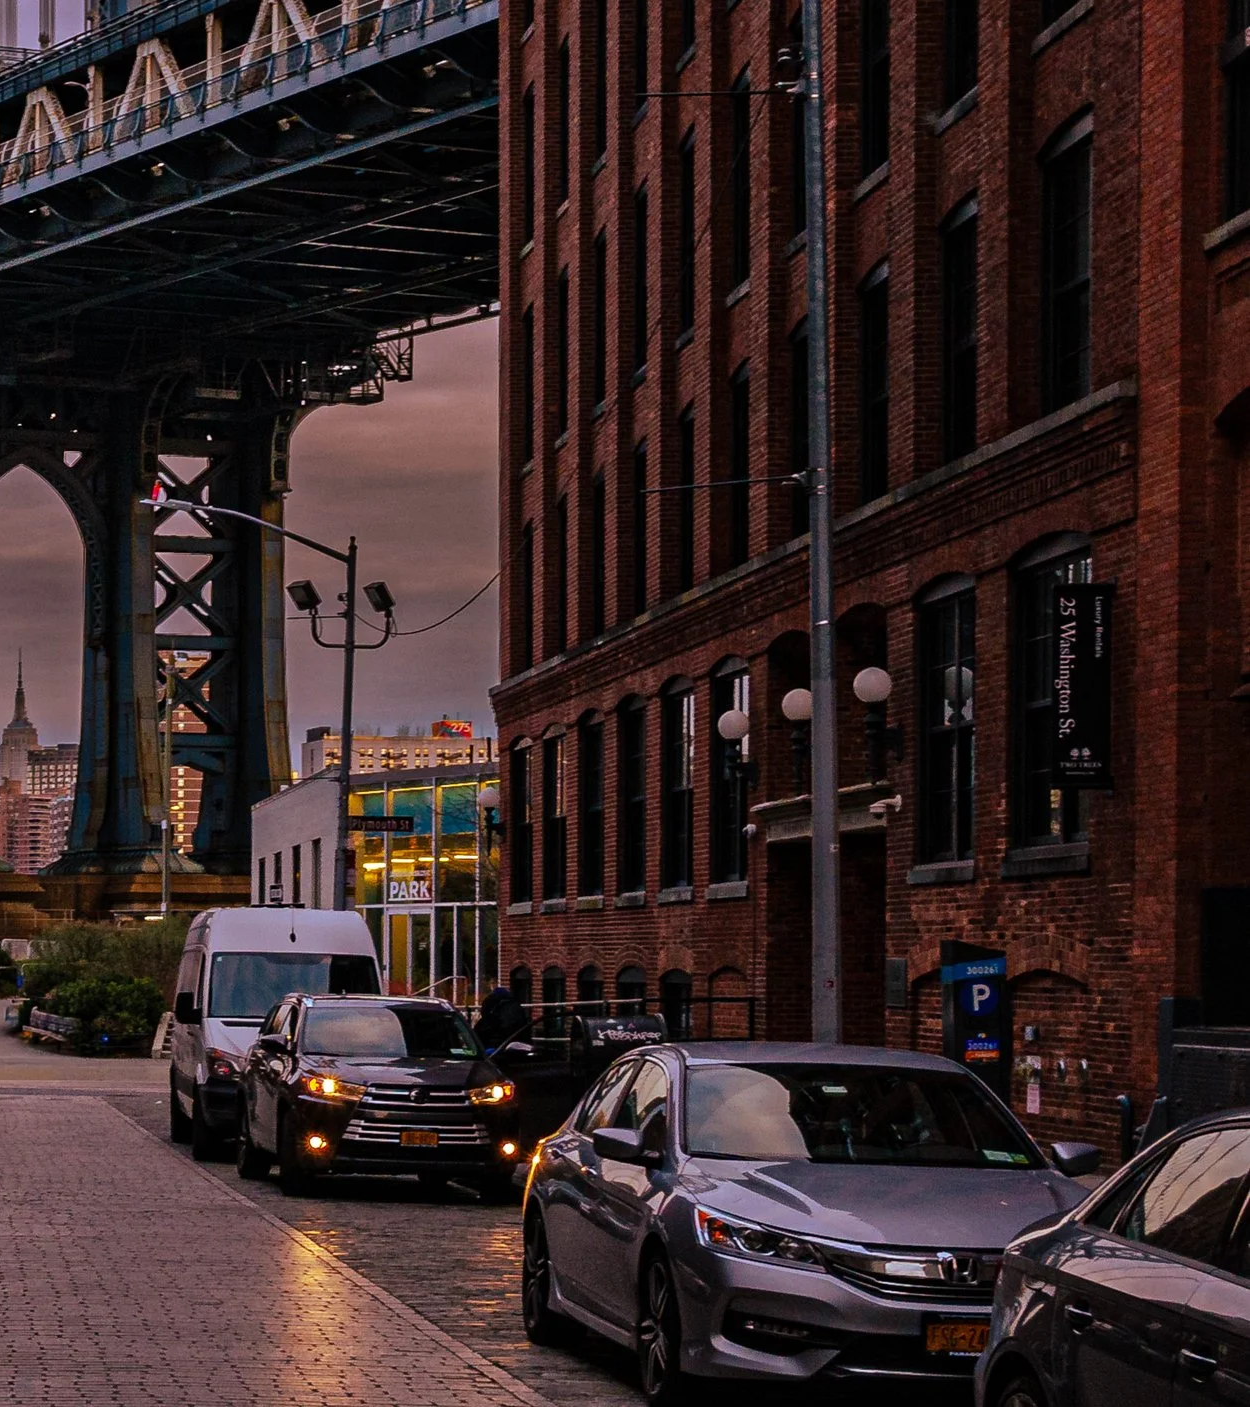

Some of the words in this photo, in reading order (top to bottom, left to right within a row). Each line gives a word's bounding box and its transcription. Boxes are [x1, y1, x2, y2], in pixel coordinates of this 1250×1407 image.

[1059, 597, 1076, 616] 25
[1093, 596, 1104, 624] Luxury
[1093, 626, 1104, 659] Rentals
[1054, 621, 1077, 714] Washington
[450, 722, 471, 733] 275
[1058, 717, 1076, 739] St.
[352, 819, 397, 831] Plymouth
[400, 819, 411, 830] St
[390, 880, 430, 899] PARK
[972, 984, 991, 1011] P
